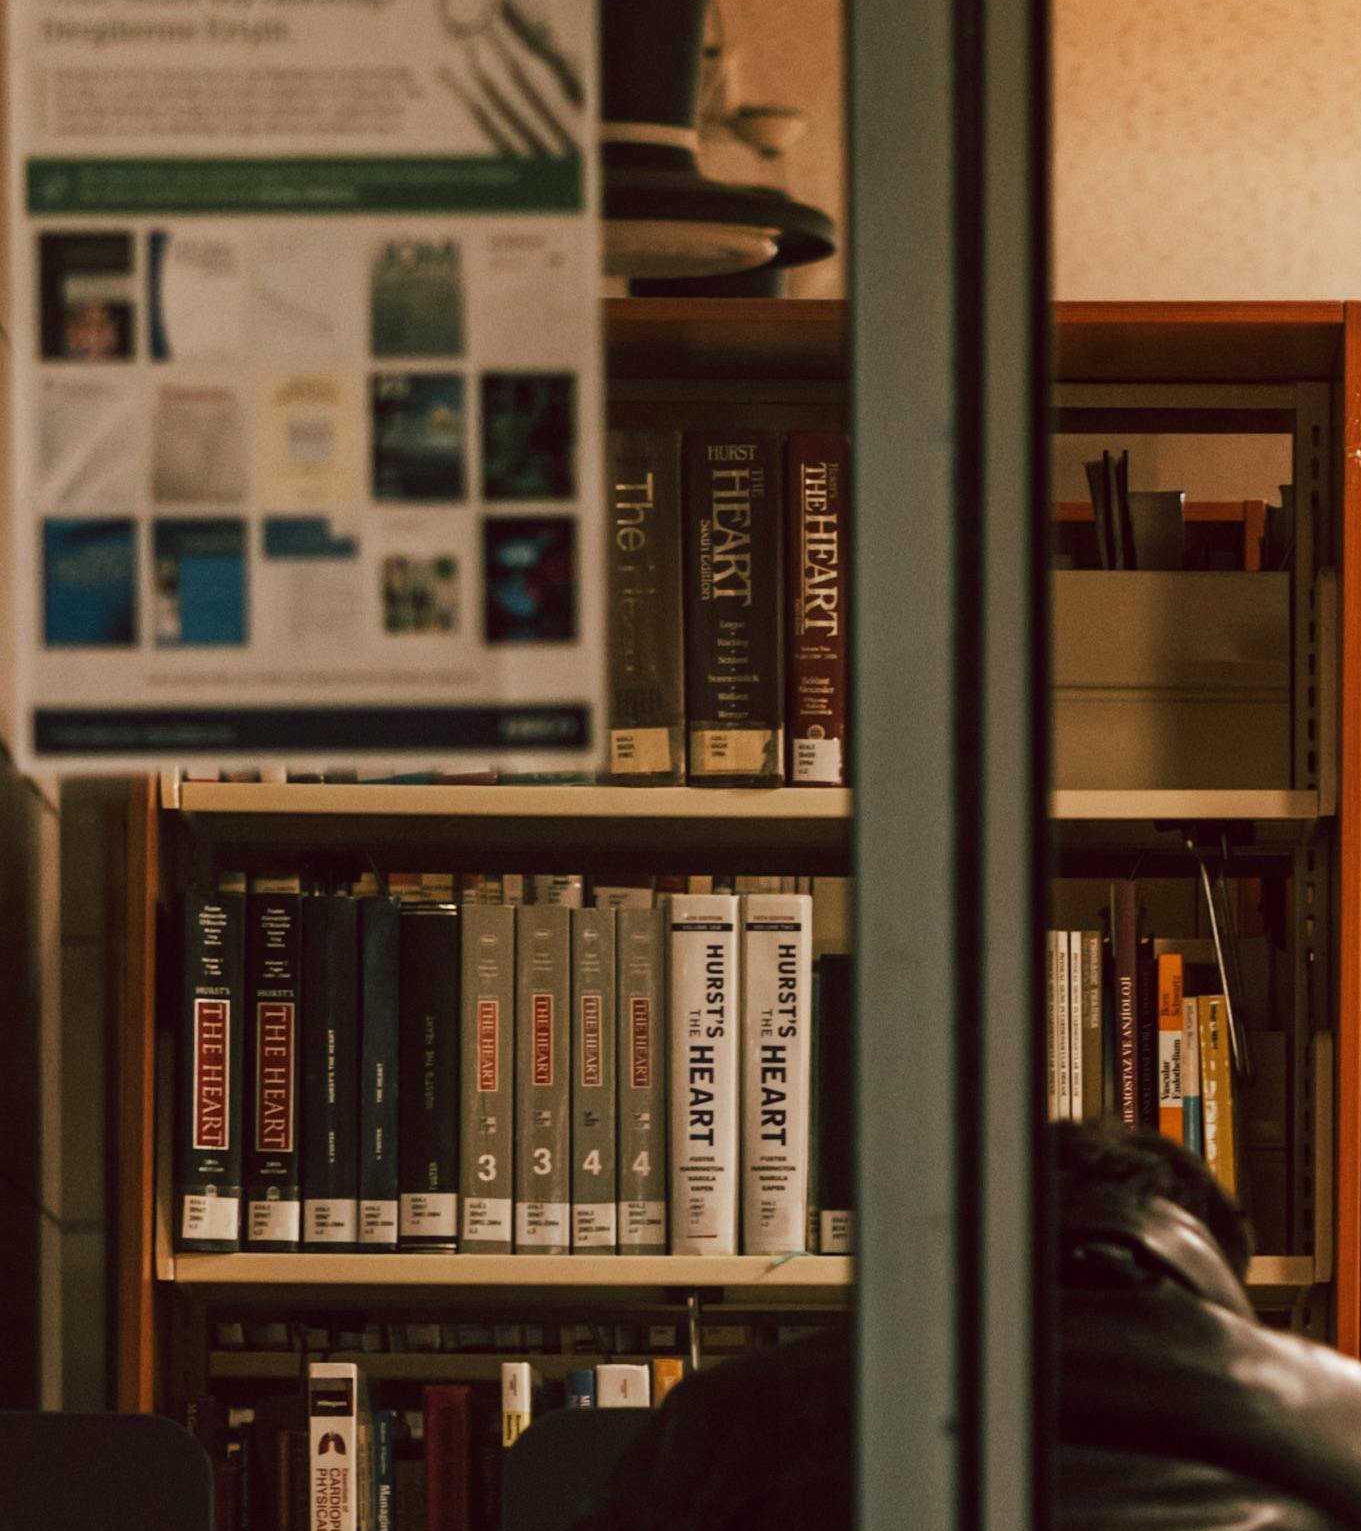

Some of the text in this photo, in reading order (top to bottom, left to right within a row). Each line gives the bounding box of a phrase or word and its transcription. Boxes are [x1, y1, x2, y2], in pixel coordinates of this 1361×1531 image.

[707, 445, 757, 461] HURST
[804, 462, 838, 638] THE HEART
[706, 944, 724, 1038] HURST'S
[778, 944, 797, 1038] HURST'S
[202, 1004, 222, 1145] THE HEART
[263, 1006, 286, 1149] THE HEART
[689, 1009, 714, 1146] THE HEART
[761, 1009, 786, 1146] THE HEART
[1118, 976, 1135, 1123] HEMOSTAZ VE ANJİOLOJİ
[1161, 1061, 1171, 1101] Vascular
[1171, 1039, 1182, 1100] Endothelium
[478, 1154, 497, 1182] 3
[533, 1148, 552, 1175] 3
[583, 1149, 602, 1176] 4
[632, 1150, 651, 1176] 4
